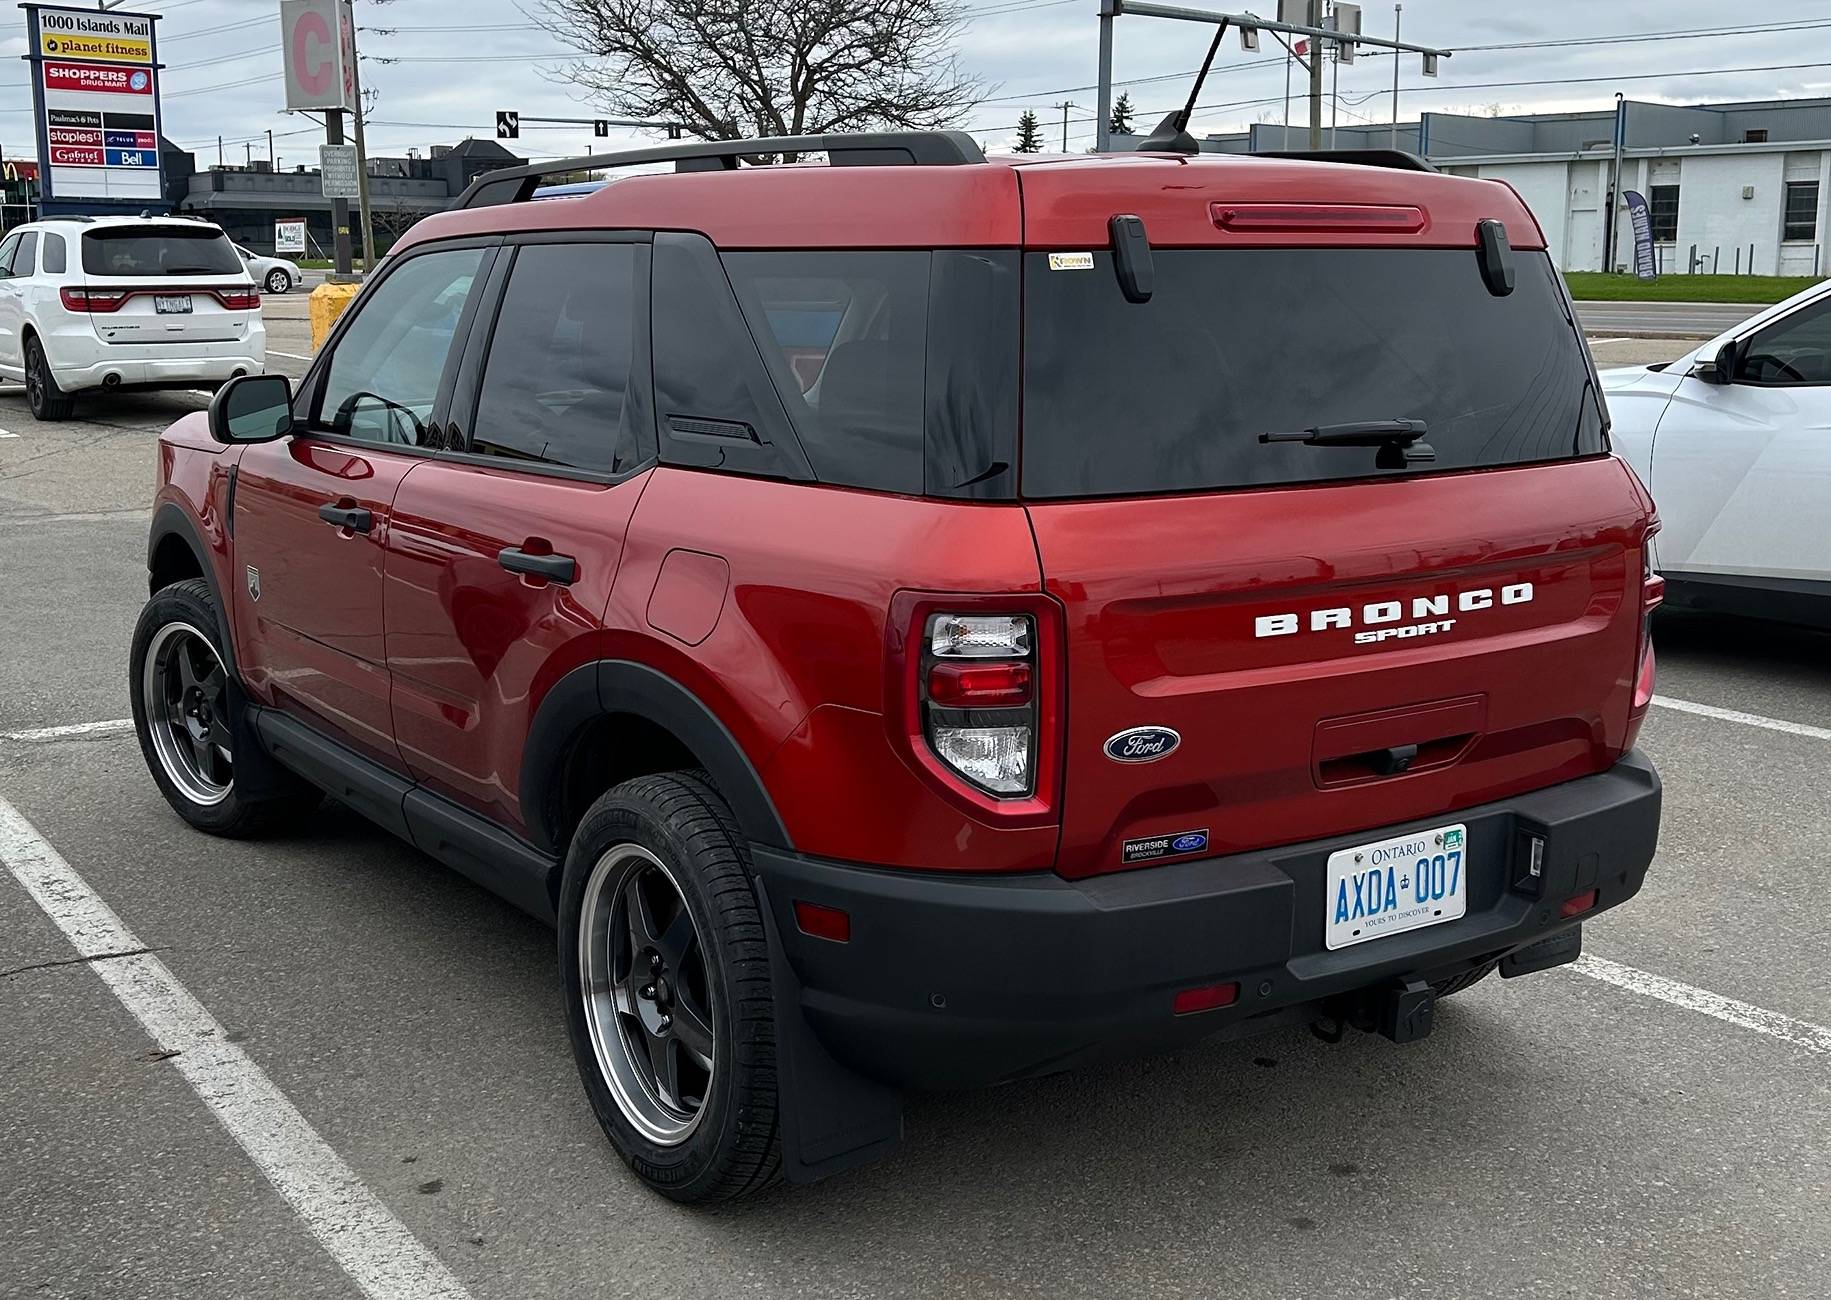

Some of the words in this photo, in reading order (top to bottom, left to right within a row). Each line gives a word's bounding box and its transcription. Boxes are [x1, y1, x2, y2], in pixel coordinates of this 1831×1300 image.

[41, 15, 74, 30] 1000
[77, 18, 120, 34] Islands
[124, 22, 149, 36] Mall
[61, 40, 103, 53] planet
[106, 43, 148, 56] fitness
[49, 67, 127, 81] SHOPPERS
[81, 79, 104, 87] DRUG
[50, 130, 94, 143] staples
[56, 149, 99, 160] Gabriel
[121, 152, 142, 165] Bell
[1637, 242, 1654, 278] BRAND
[1255, 582, 1534, 638] BRONCO
[1354, 619, 1457, 645] SPORT
[1123, 733, 1166, 756] Ford
[1125, 839, 1169, 853] RIVERSIDE
[1178, 836, 1200, 848] Ford
[1371, 841, 1426, 865] ONTARIO
[1334, 865, 1398, 925] AXDA
[1416, 850, 1462, 904] 007
[1364, 916, 1386, 928] YOURS
[1388, 914, 1397, 922] TO
[1398, 906, 1430, 919] DISCOVER
